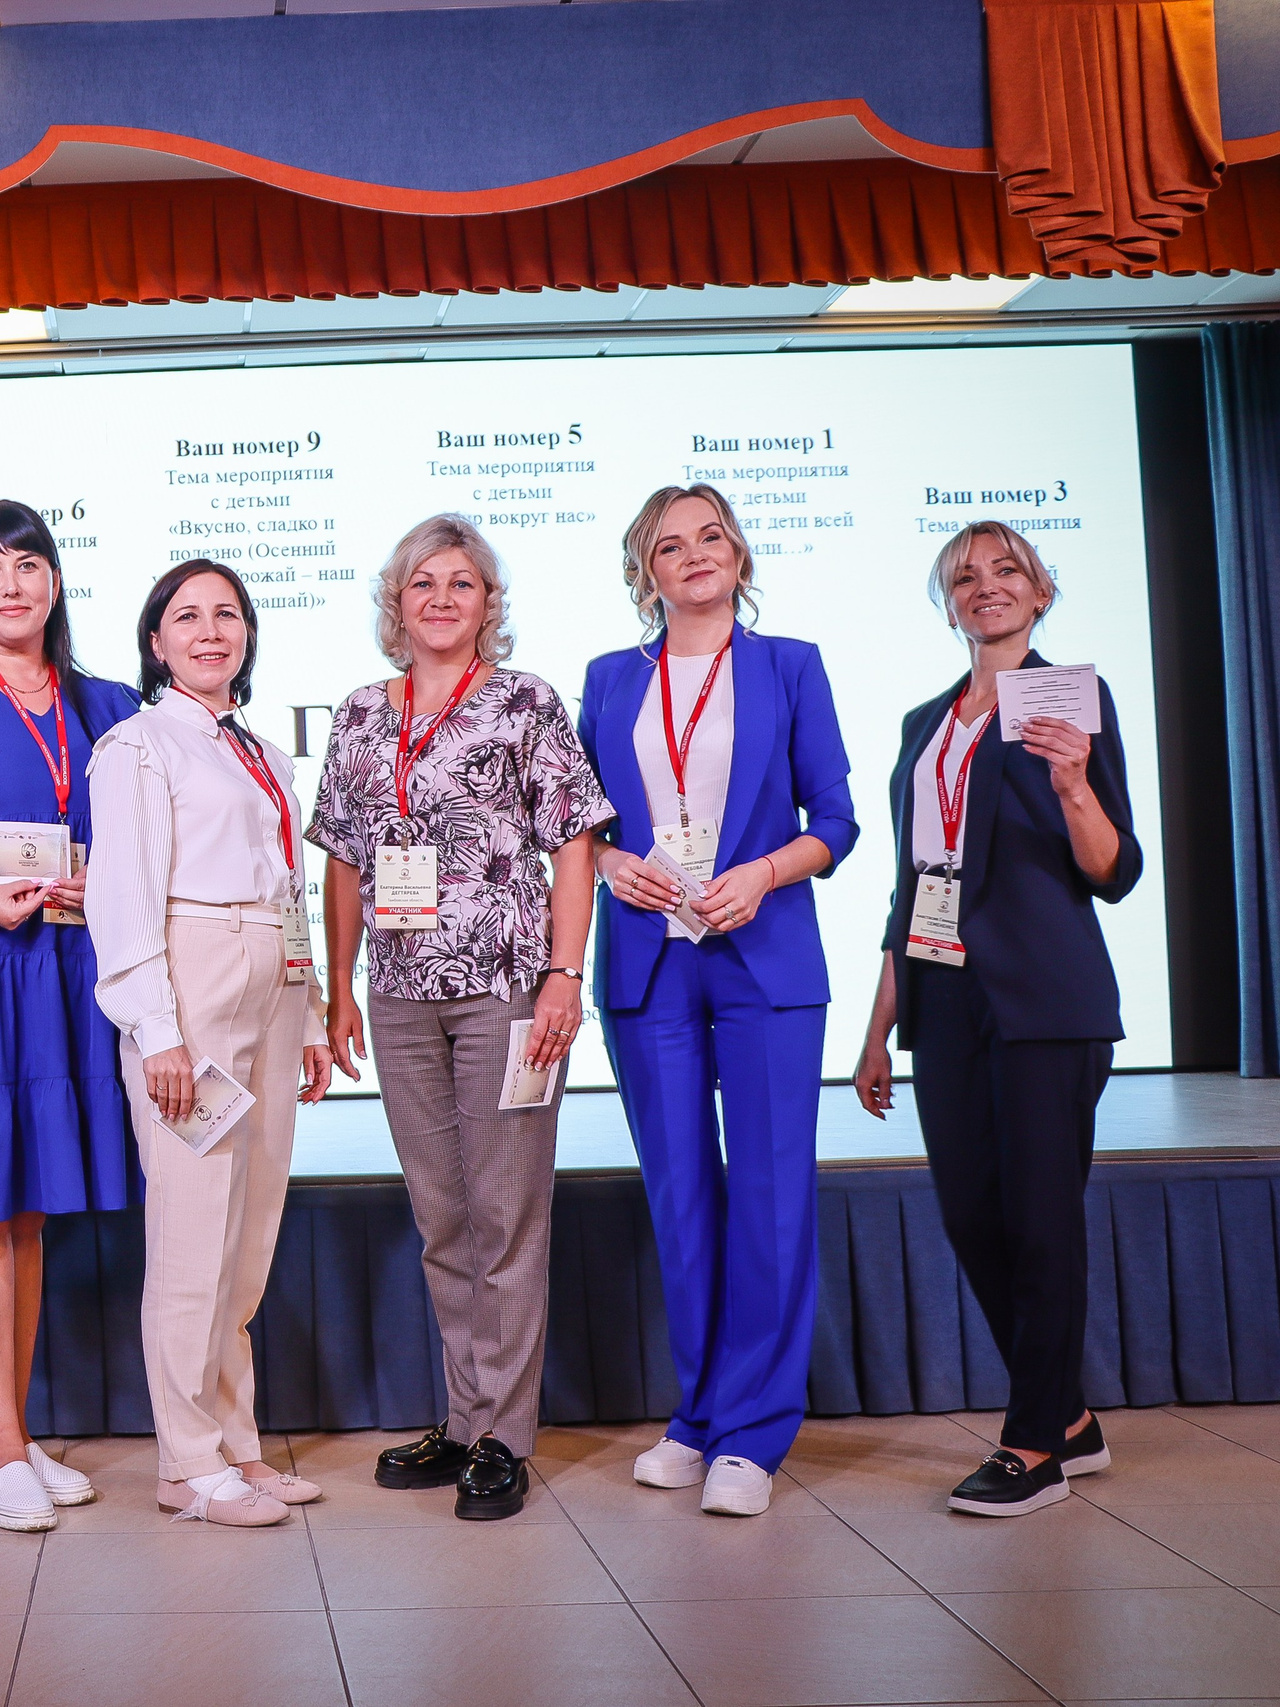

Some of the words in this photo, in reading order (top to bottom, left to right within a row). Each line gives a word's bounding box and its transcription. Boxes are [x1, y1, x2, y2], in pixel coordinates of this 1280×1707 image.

[176, 439, 224, 457] Ваш
[232, 438, 300, 458] номер
[306, 430, 321, 453] 9
[436, 430, 485, 448] Ваш
[493, 431, 560, 450] номер
[568, 423, 583, 445] 5
[691, 434, 739, 453] Ваш
[747, 436, 814, 454] номер
[822, 427, 835, 449] 1
[165, 469, 210, 485] Тема
[215, 467, 334, 486] мероприятия
[426, 460, 471, 476] Тема
[477, 460, 596, 478] мероприятия
[682, 465, 726, 480] Тема
[732, 464, 850, 482] мероприятия
[210, 497, 220, 509] с
[225, 495, 291, 510] детьми
[472, 489, 482, 500] с
[487, 487, 553, 502] детьми
[727, 493, 737, 505] с
[742, 491, 808, 506] детьми
[925, 487, 973, 505] Ваш
[980, 488, 1047, 507] номер
[1053, 479, 1068, 502] 3
[71, 498, 86, 520] 6
[489, 512, 550, 528] вокруг
[555, 510, 596, 523] нас»
[168, 519, 251, 538] «Вкусно,
[257, 519, 319, 532] сладко
[324, 518, 335, 530] и
[767, 516, 808, 530] дети
[813, 510, 854, 528] всей
[914, 517, 959, 533] Тема
[169, 547, 243, 561] полезно
[248, 539, 336, 561] (Осенний
[318, 568, 355, 581] наш
[937, 777, 947, 810] ВОСПИТАТЕЛЬ
[951, 786, 961, 820] ВОСПИТАТЕЛЬ
